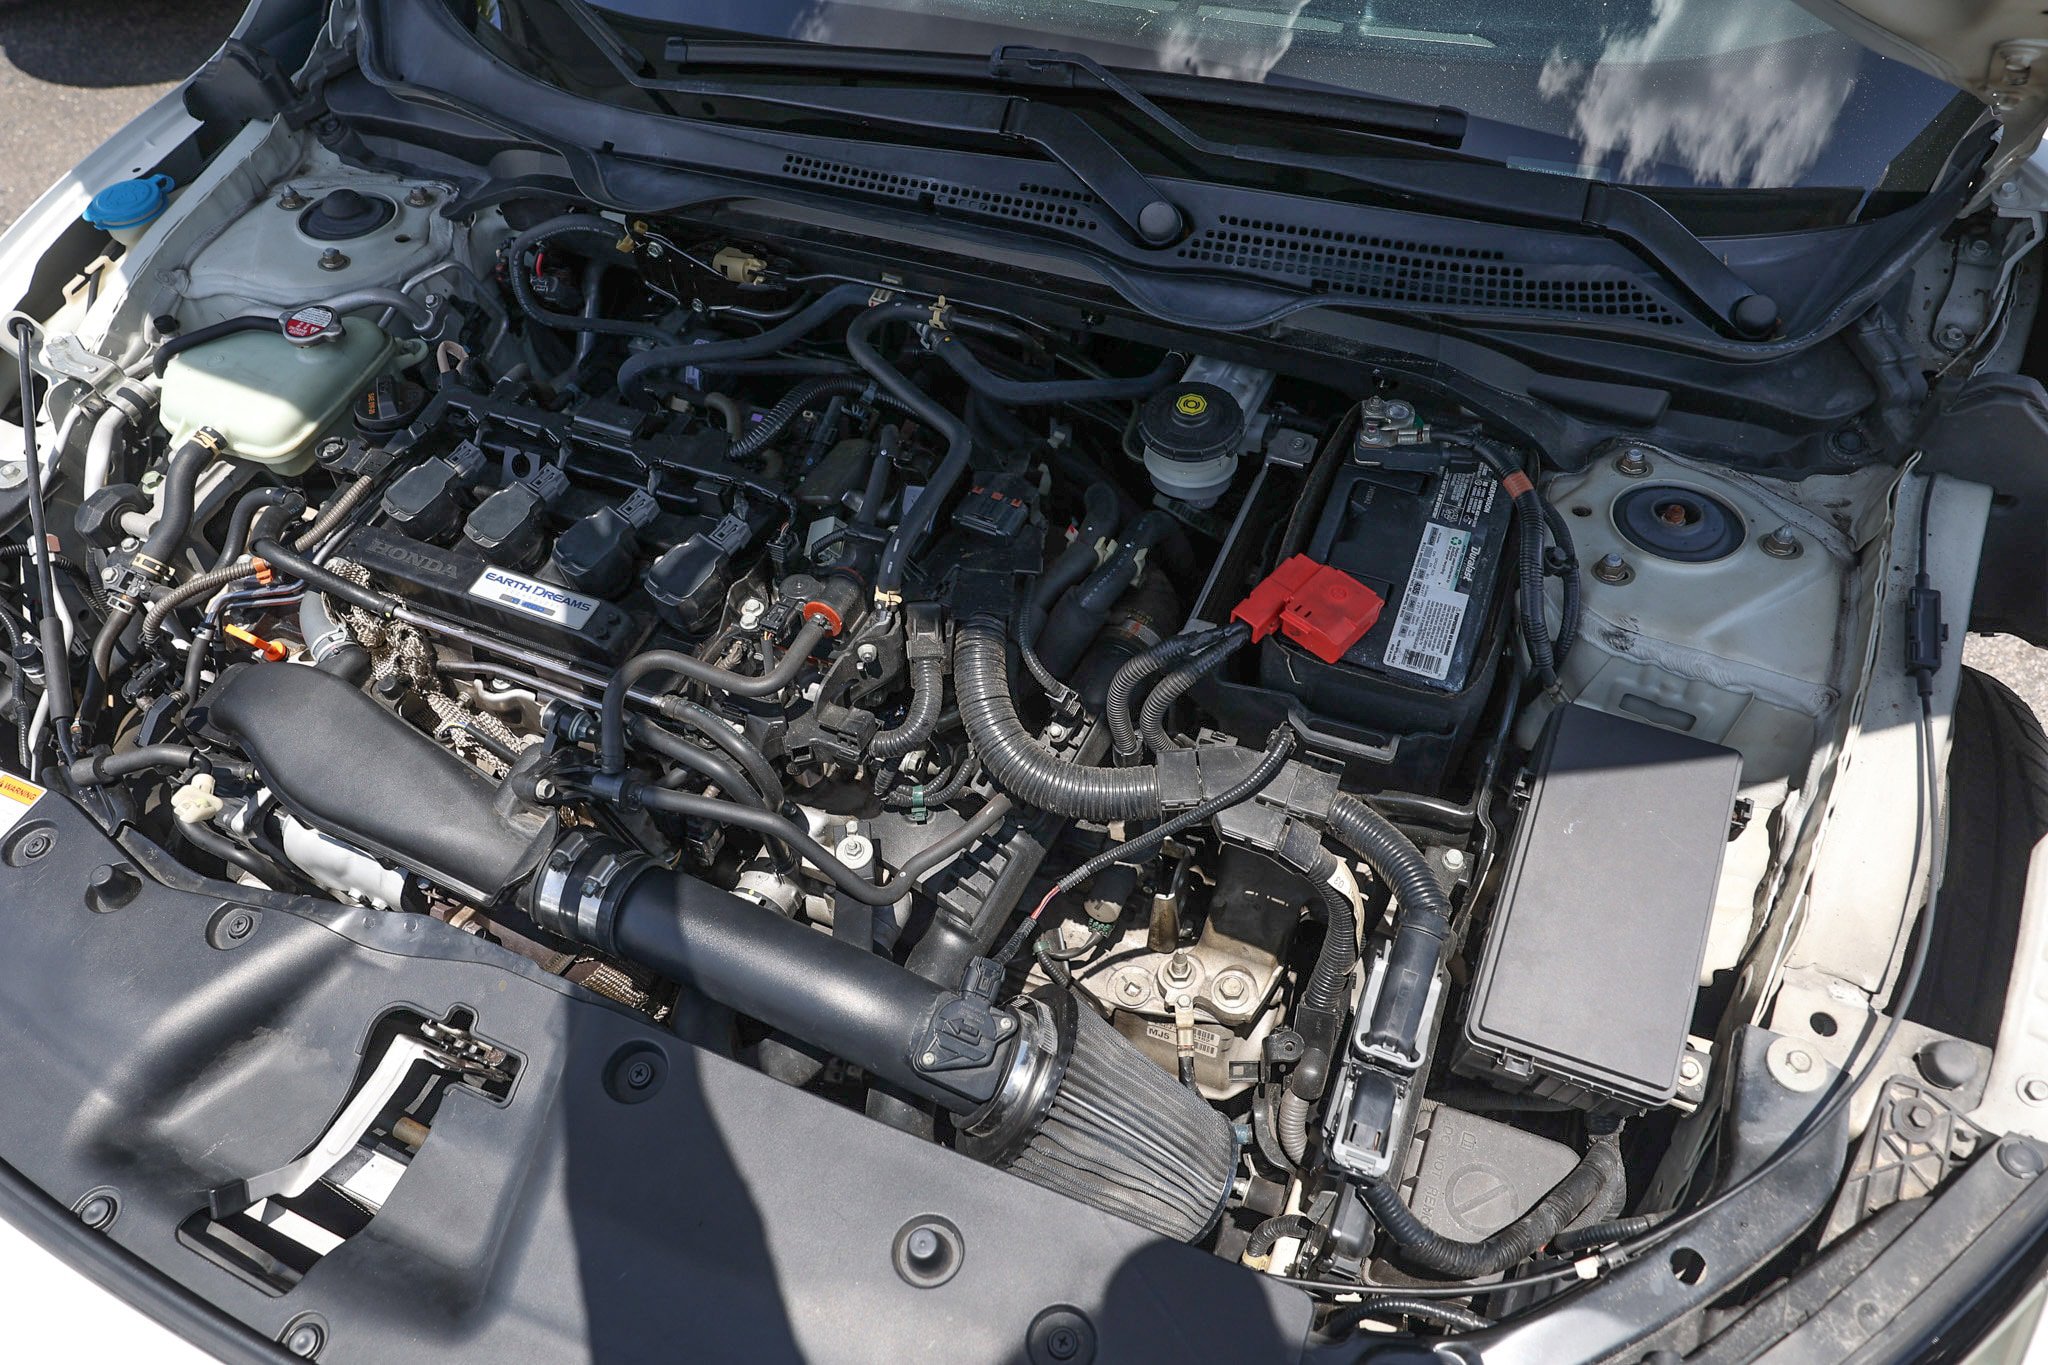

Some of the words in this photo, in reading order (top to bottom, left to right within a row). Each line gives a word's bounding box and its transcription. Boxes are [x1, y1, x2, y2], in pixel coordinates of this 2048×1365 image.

[1483, 479, 1498, 513] NGER/POISON
[366, 540, 460, 579] HONDA
[1462, 544, 1481, 582] Duralast
[485, 572, 532, 592] EARTH
[532, 586, 592, 612] DREAMS
[1412, 581, 1421, 594] 435
[4, 782, 37, 801] WARNING
[1441, 1126, 1453, 1142] DO
[1432, 1152, 1447, 1177] NOT
[1421, 1186, 1438, 1224] REMO
